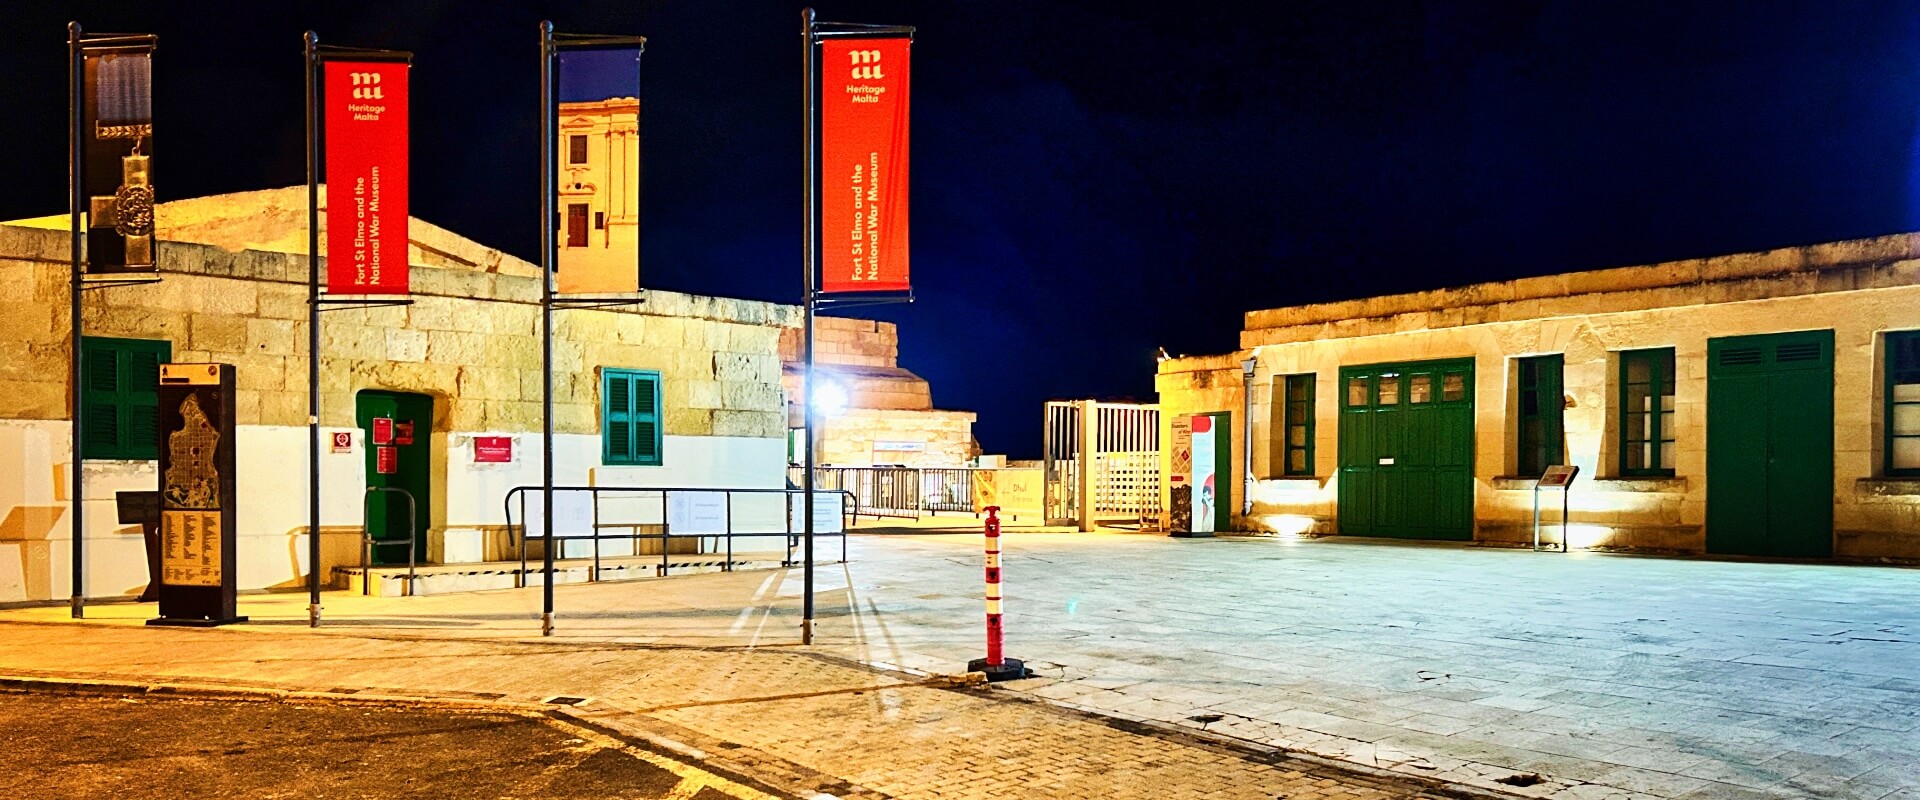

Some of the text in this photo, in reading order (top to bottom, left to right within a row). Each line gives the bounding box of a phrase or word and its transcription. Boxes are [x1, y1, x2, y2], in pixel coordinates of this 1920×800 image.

[348, 103, 386, 114] Heritage
[353, 113, 379, 121] Malta
[846, 84, 886, 95] Heritage
[852, 94, 879, 103] Malta
[354, 176, 366, 285] Fort St Elmo and the
[369, 165, 380, 285] National War Museum
[851, 164, 863, 281] Fort St Elmo and the
[867, 152, 879, 281] National War Museum
